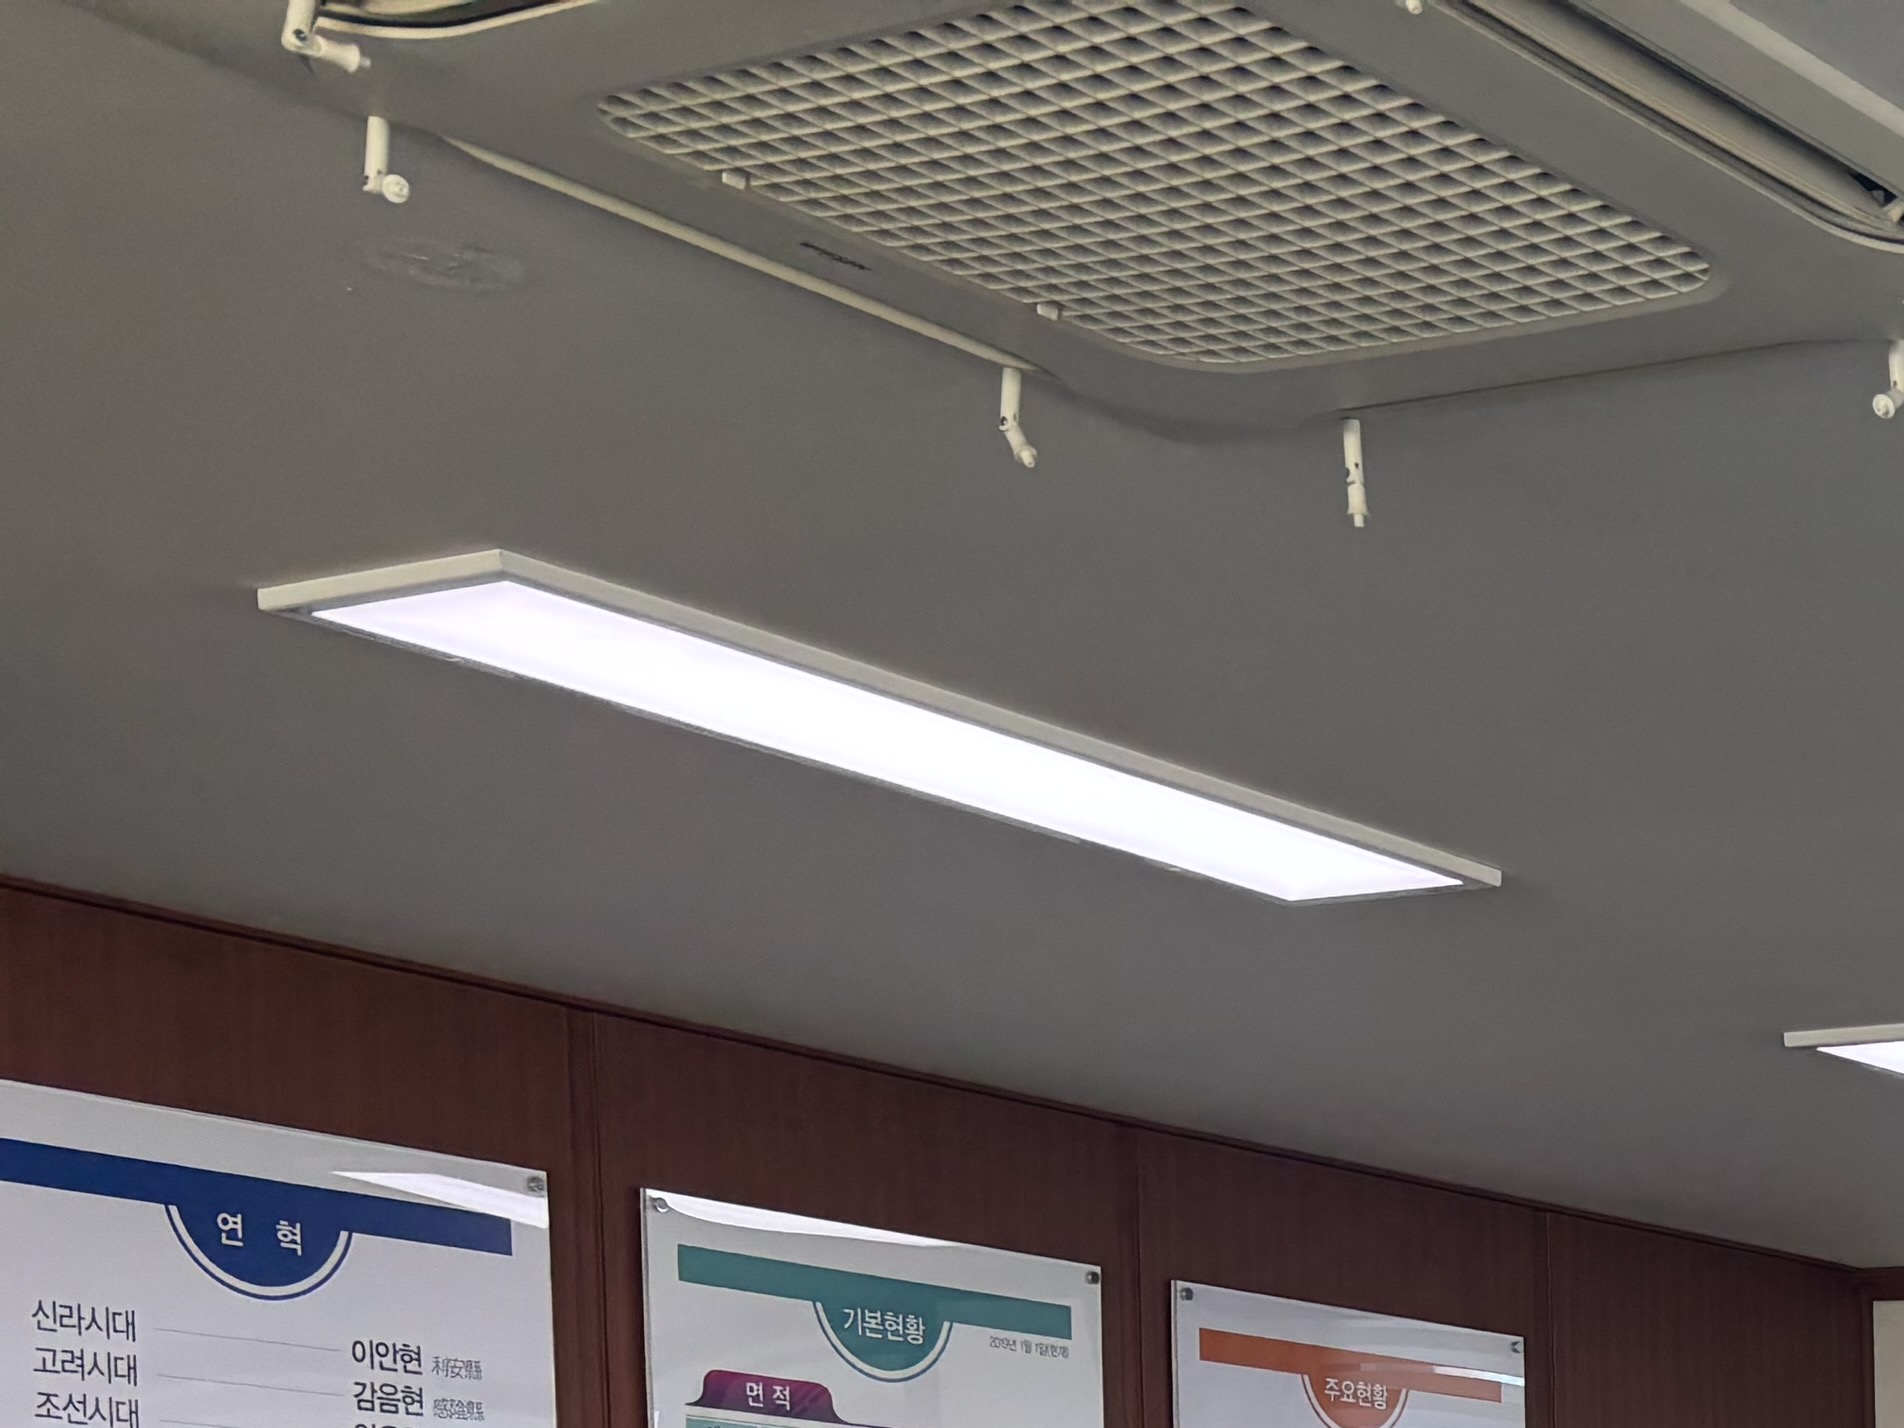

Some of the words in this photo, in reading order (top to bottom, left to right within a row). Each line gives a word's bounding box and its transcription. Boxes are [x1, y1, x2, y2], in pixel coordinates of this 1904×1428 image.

[216, 1212, 244, 1247] 연
[275, 1219, 303, 1257] 혁
[31, 1299, 136, 1343] 신라시대
[351, 1339, 423, 1376] 이안현
[842, 1307, 926, 1345] 기본현황
[33, 1346, 138, 1387] 고려시대
[353, 1380, 424, 1417] 감음현
[745, 1382, 764, 1408] 면
[772, 1385, 791, 1411] 적
[1324, 1377, 1389, 1410] 주요현황
